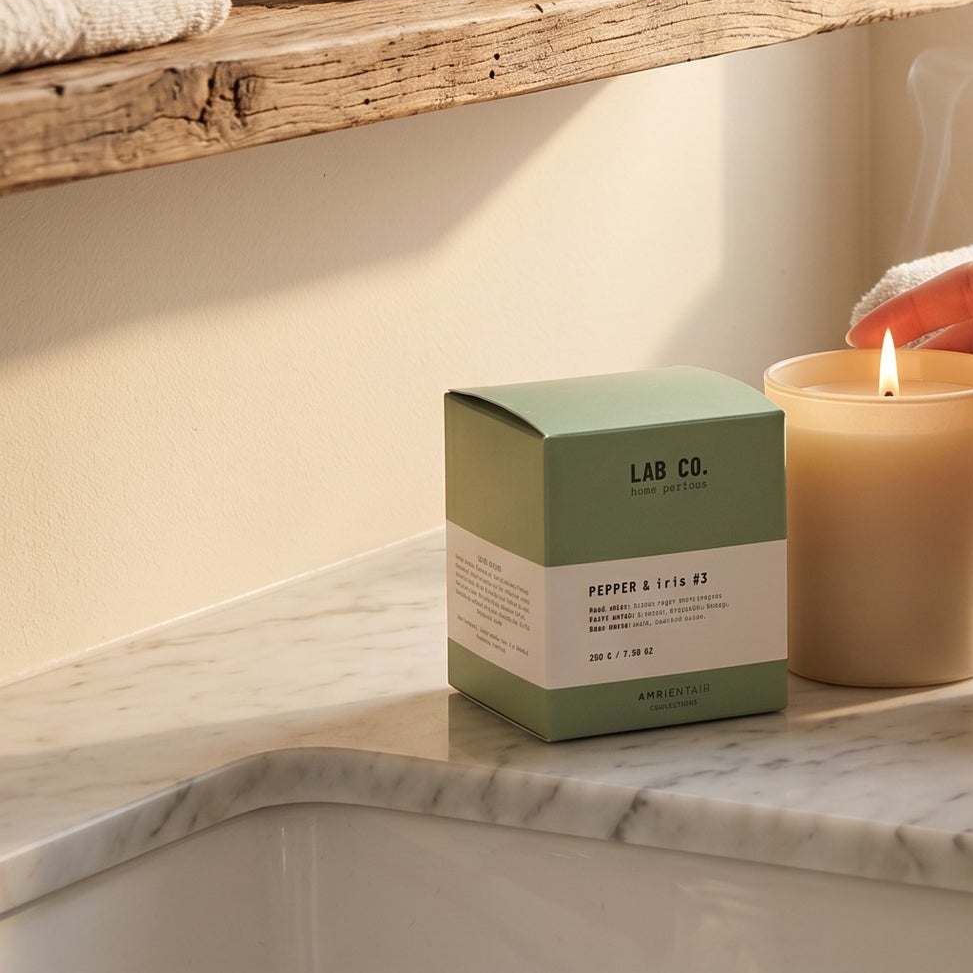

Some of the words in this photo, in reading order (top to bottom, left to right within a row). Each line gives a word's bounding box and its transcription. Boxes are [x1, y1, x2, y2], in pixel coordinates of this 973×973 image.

[631, 460, 667, 484] LAB
[678, 456, 708, 478] CO.
[631, 486, 657, 497] home
[589, 580, 637, 597] PEPPER
[642, 580, 650, 591] &
[656, 577, 686, 589] iris
[693, 572, 708, 586] #3
